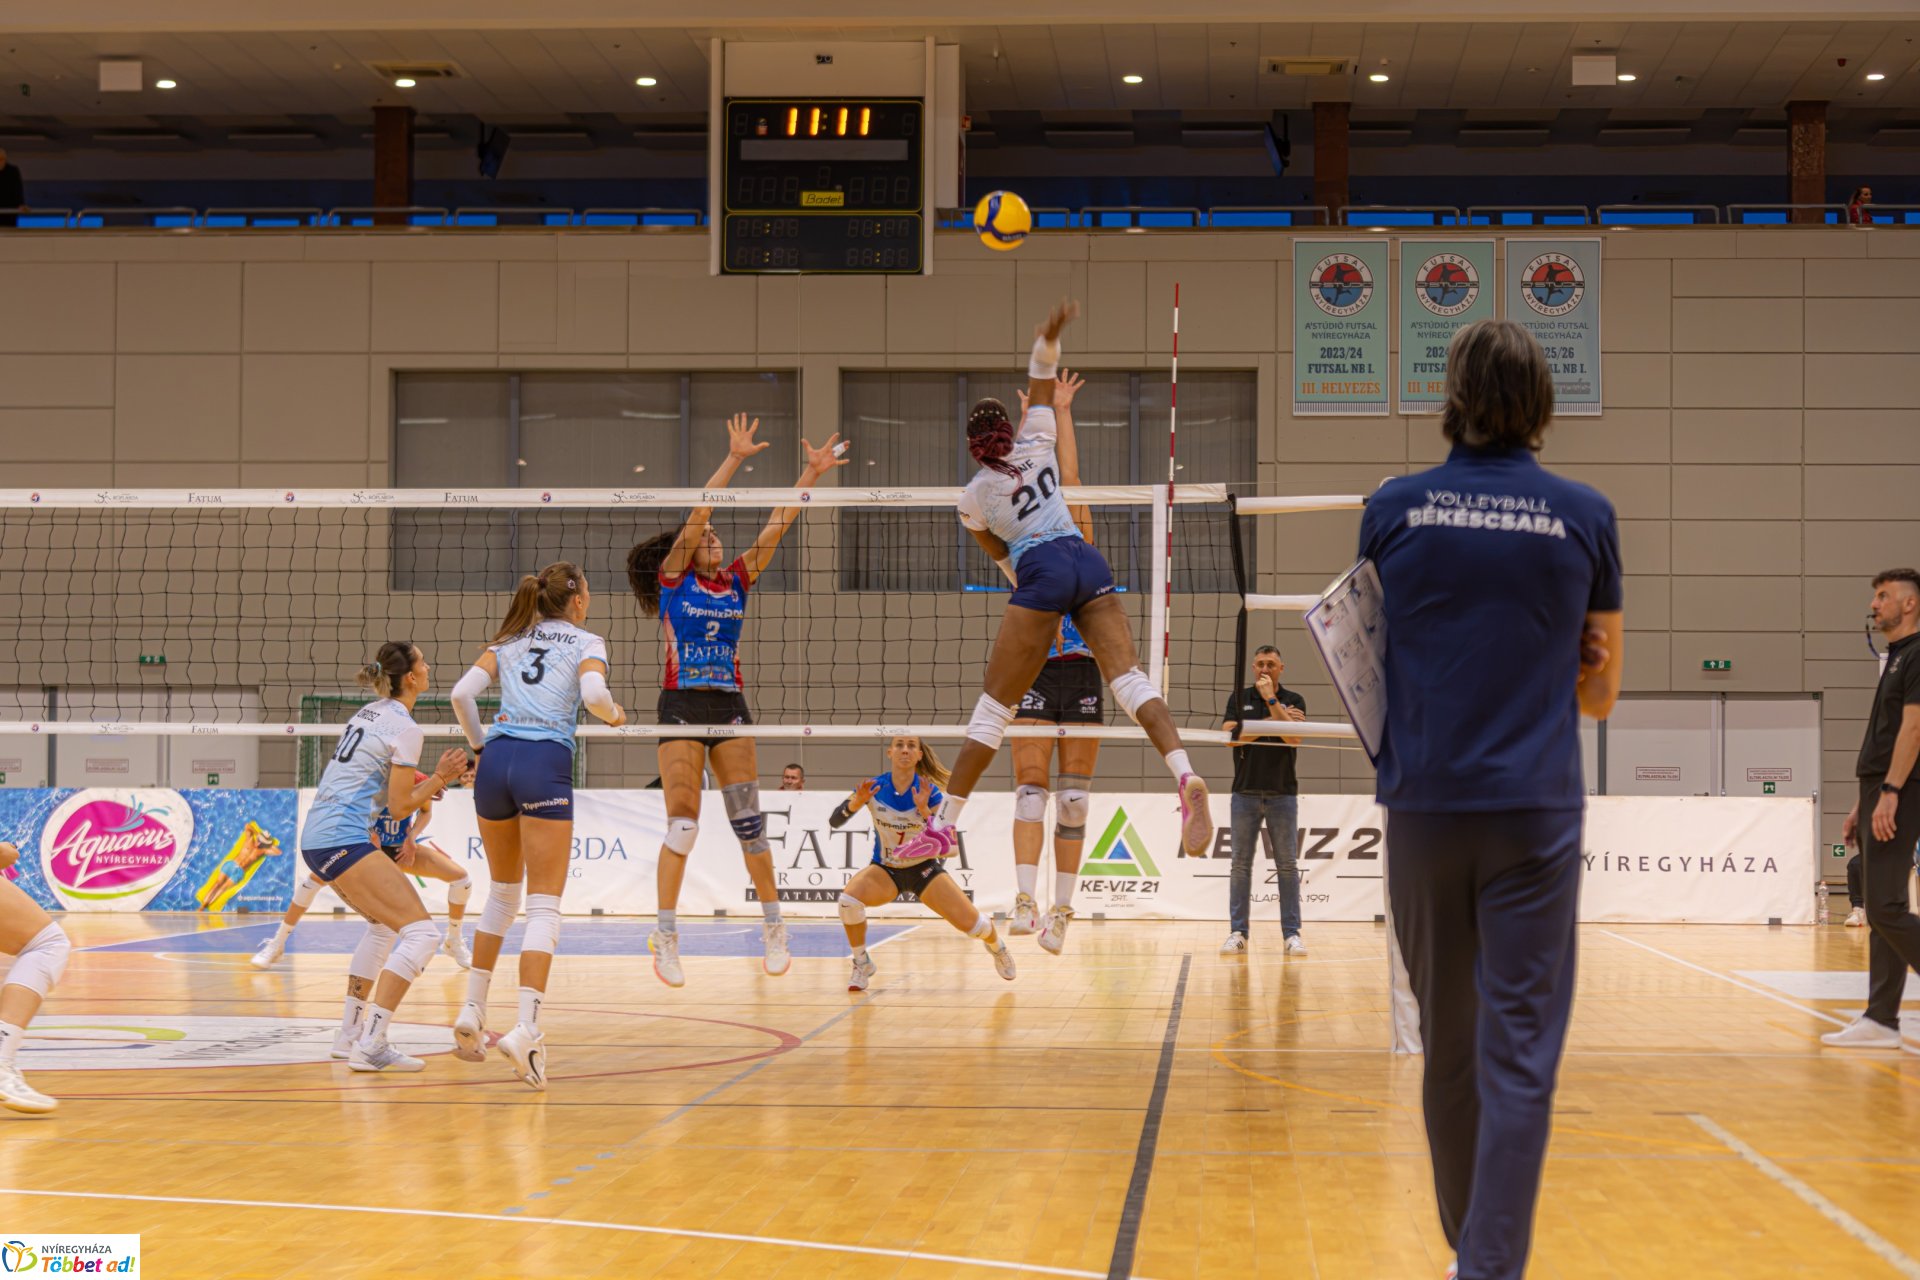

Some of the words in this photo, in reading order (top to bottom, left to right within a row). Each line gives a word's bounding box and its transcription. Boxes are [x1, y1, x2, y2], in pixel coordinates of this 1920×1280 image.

[786, 107, 870, 136] 11:11
[807, 193, 841, 204] Bodet
[1317, 255, 1364, 272] FUTSAL
[1423, 255, 1471, 272] FUTSAL
[1529, 255, 1576, 272] FUTSAL
[1314, 294, 1368, 315] NYÍREGYHÁZA
[1420, 294, 1474, 315] NYÍREGYHÁZA
[1526, 294, 1580, 315] NYÍREGYHÁZA
[1346, 322, 1377, 330] FUTSAL
[1558, 322, 1589, 330] FUTSAL
[1312, 331, 1370, 339] NYÍREGYHÁZA
[1417, 331, 1453, 339] NYÍREGY
[1535, 331, 1582, 339] ÍREGYHÁZA
[1320, 346, 1363, 360] 2023/24
[1544, 346, 1575, 360] 25/26
[1308, 363, 1348, 374] FUTSAL
[1351, 363, 1366, 374] NB
[1367, 363, 1375, 374] I.
[1413, 363, 1447, 373] FUTSA
[1563, 363, 1577, 373] NB
[1580, 363, 1587, 373] I.
[1322, 380, 1381, 394] HELYEZÉS
[188, 493, 222, 503] FATUM
[445, 492, 479, 503] FATUM
[702, 492, 737, 503] FATUM
[1012, 467, 1057, 521] 20
[1425, 489, 1551, 513] VOLLEYBALL
[1407, 504, 1567, 539] BÉKÉSCSABA
[705, 621, 720, 641] 2
[521, 647, 550, 685] 3
[1021, 694, 1044, 710] 23
[191, 725, 219, 734] FATUM
[707, 727, 735, 735] FATUM
[332, 724, 364, 763] 10
[384, 820, 400, 835] 10
[896, 831, 905, 846] 7
[1347, 827, 1383, 860] 2
[50, 820, 174, 888] Aquarius
[95, 853, 170, 865] NYÍREGYHÁZA
[1584, 852, 1778, 873] YÍREGYHÁZA
[1080, 880, 1138, 893] KE-VIZ
[1140, 881, 1160, 893] 21
[1306, 893, 1330, 903] 1991
